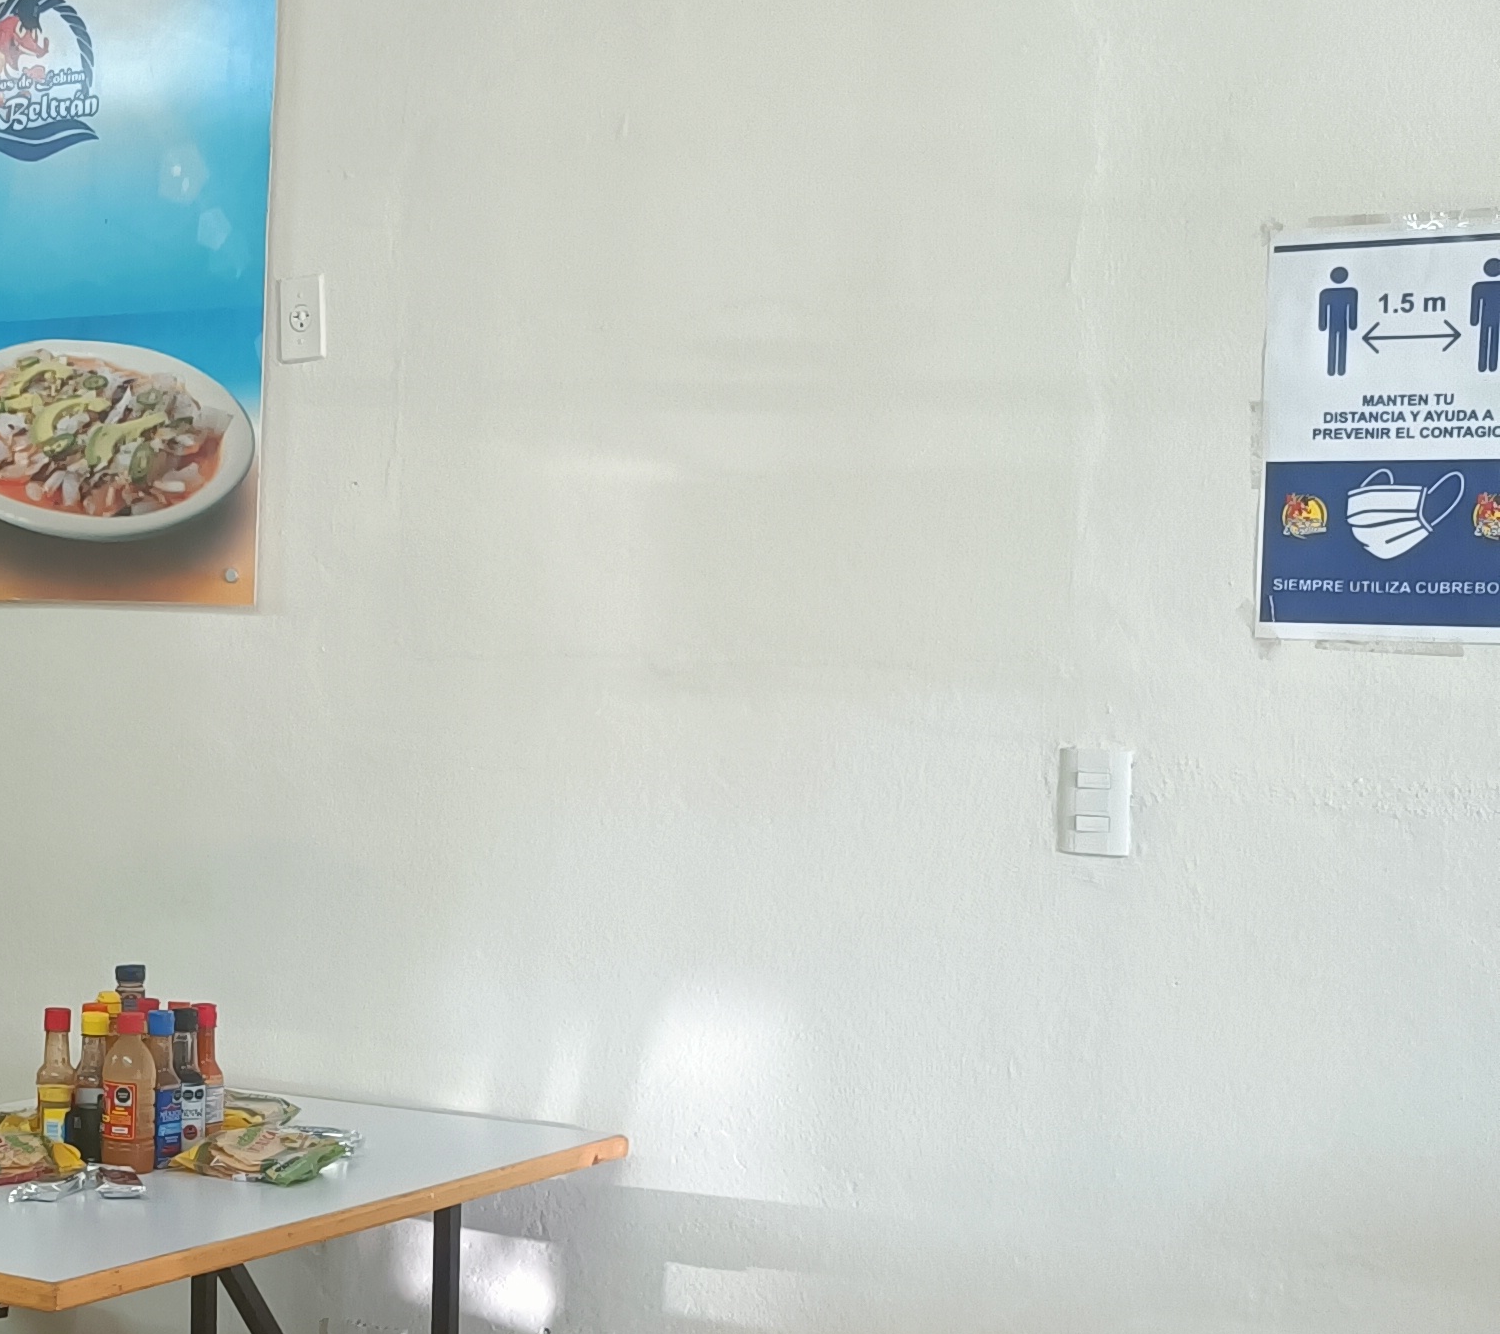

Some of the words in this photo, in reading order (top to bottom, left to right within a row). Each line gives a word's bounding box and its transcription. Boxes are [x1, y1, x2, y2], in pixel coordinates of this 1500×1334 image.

[18, 75, 32, 88] de
[1378, 293, 1415, 314] 1.5
[1423, 296, 1446, 312] m
[1362, 394, 1429, 407] MANTEN
[1434, 393, 1455, 406] TU
[1323, 410, 1406, 424] DISTANCIA
[1410, 410, 1421, 422] Y
[1423, 409, 1479, 422] AYUDA
[1482, 409, 1494, 421] A
[1312, 427, 1391, 440] PREVENIR
[1395, 427, 1415, 439] EL
[1272, 578, 1344, 593] SIEMPRE
[1349, 580, 1411, 594] UTILIZA
[1415, 581, 1500, 595] CUBREBO
